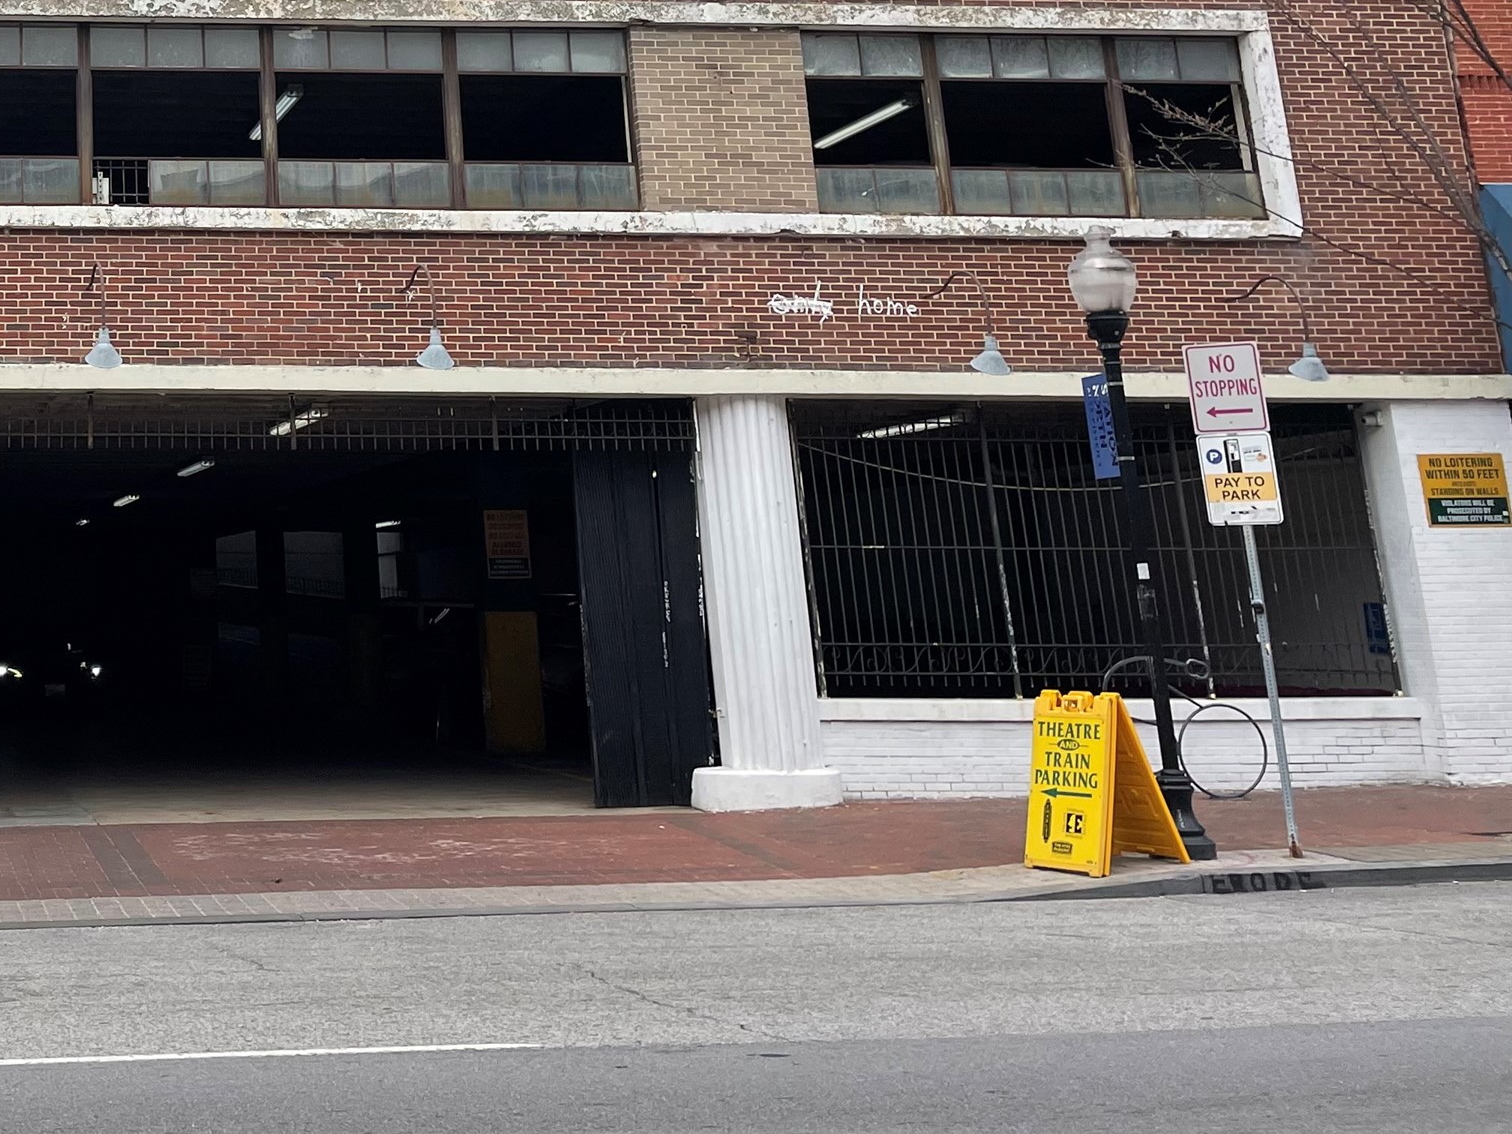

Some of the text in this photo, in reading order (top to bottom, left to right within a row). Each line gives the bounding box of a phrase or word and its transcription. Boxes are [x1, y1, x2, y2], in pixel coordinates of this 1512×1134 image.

[858, 283, 919, 317] home
[1208, 354, 1235, 373] NO
[1194, 377, 1258, 397] STOPPING
[1428, 457, 1493, 468] NO LOITERING
[1214, 476, 1265, 488] PAY TO
[1425, 469, 1500, 479] WITHIN 50 FEET
[1222, 489, 1261, 501] PARK
[1038, 721, 1101, 740] THEATRE
[1059, 740, 1079, 749] AND
[1045, 751, 1091, 770] TRAIN
[1034, 769, 1098, 789] PARKING
